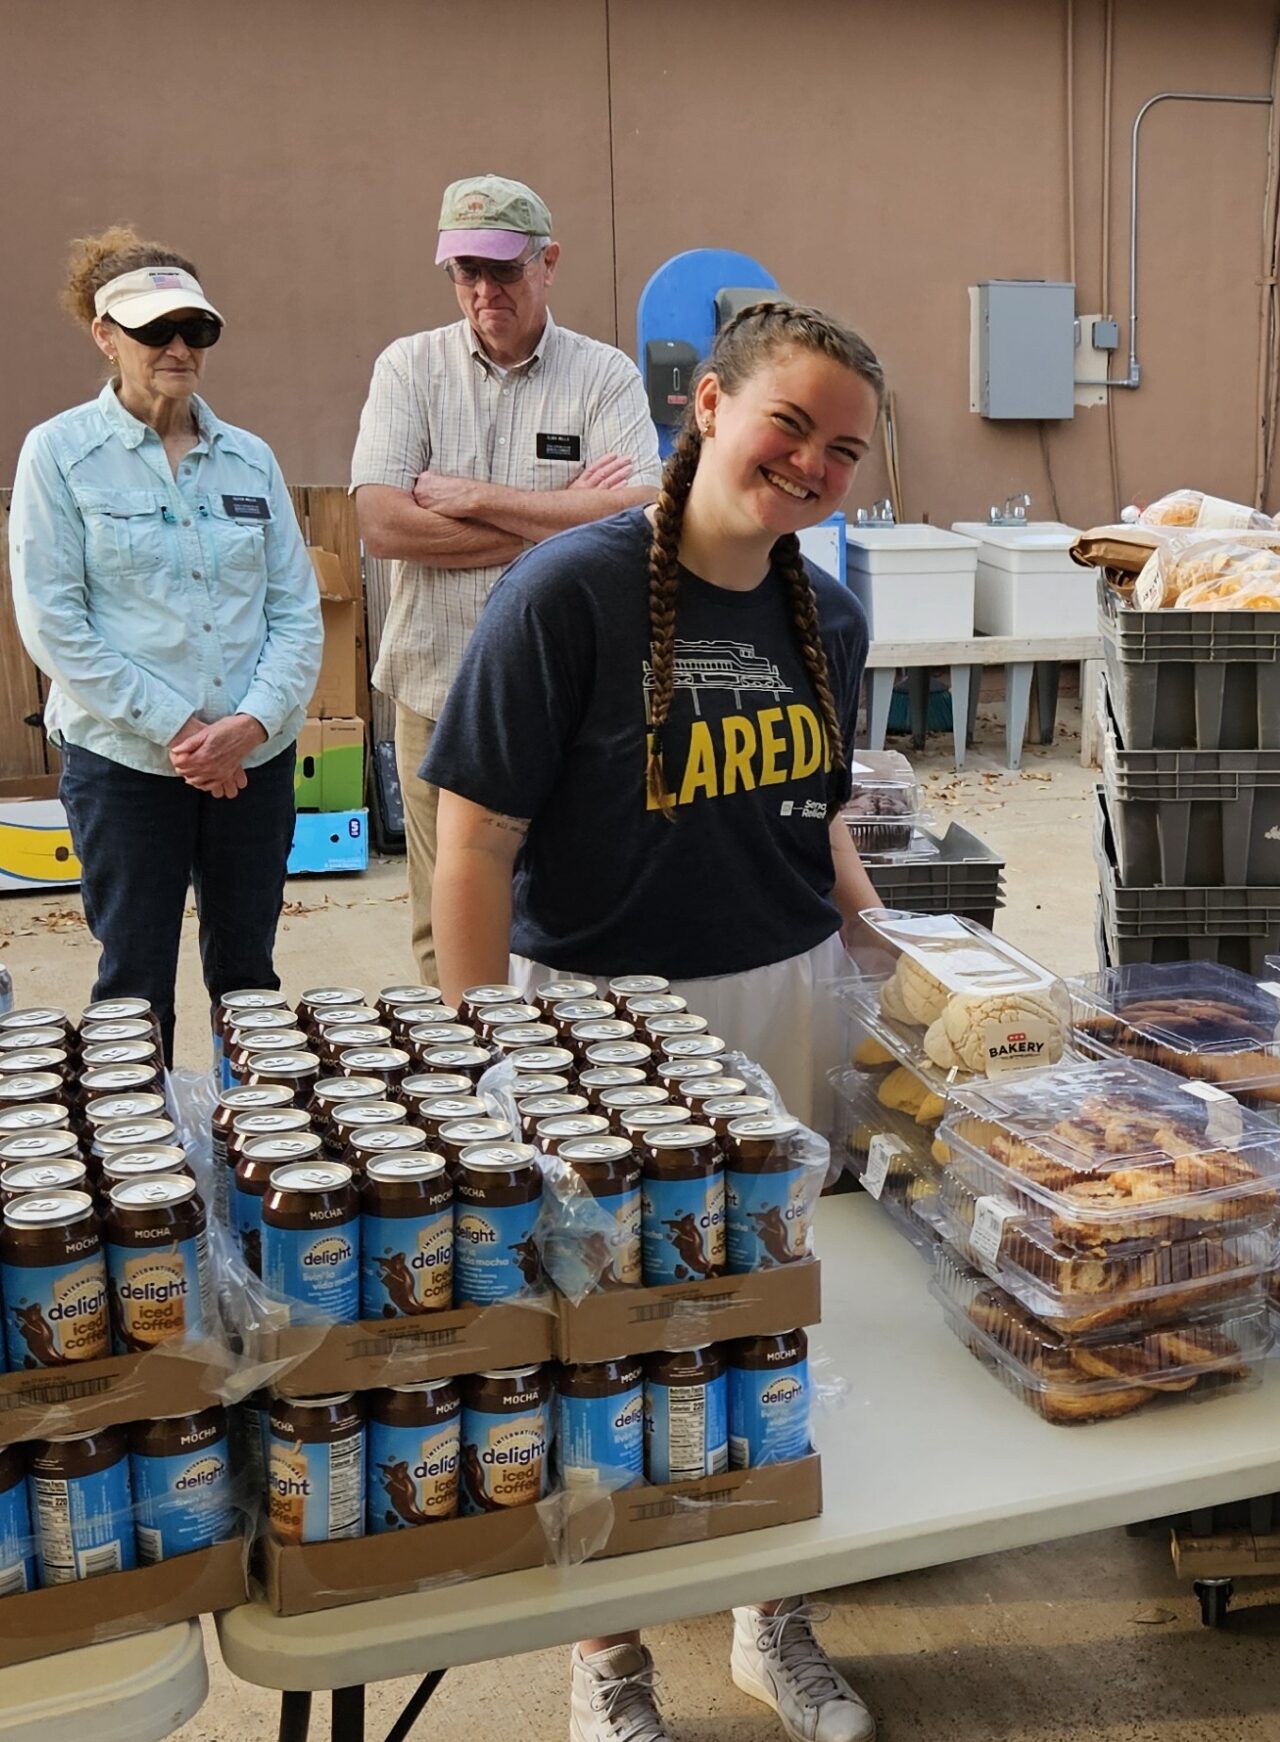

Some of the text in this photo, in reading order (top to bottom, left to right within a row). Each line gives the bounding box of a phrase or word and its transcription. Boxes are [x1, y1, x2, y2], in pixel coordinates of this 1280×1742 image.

[646, 703, 832, 811] LARED
[350, 820, 359, 832] 5
[988, 1041, 1045, 1058] BAKERY
[309, 1207, 343, 1221] MOCHA
[134, 1226, 171, 1239] MOCHA
[303, 1244, 352, 1266] delight
[120, 1277, 188, 1303] delight
[139, 1302, 173, 1319] iced
[132, 1316, 184, 1332] coffee
[767, 1349, 797, 1361] MOCHA
[503, 1391, 539, 1405] MOCHA
[761, 1384, 803, 1404] delight
[180, 1426, 217, 1446] MOCHA
[482, 1438, 546, 1466] delight
[502, 1464, 534, 1483] iced
[493, 1476, 540, 1495] coffee
